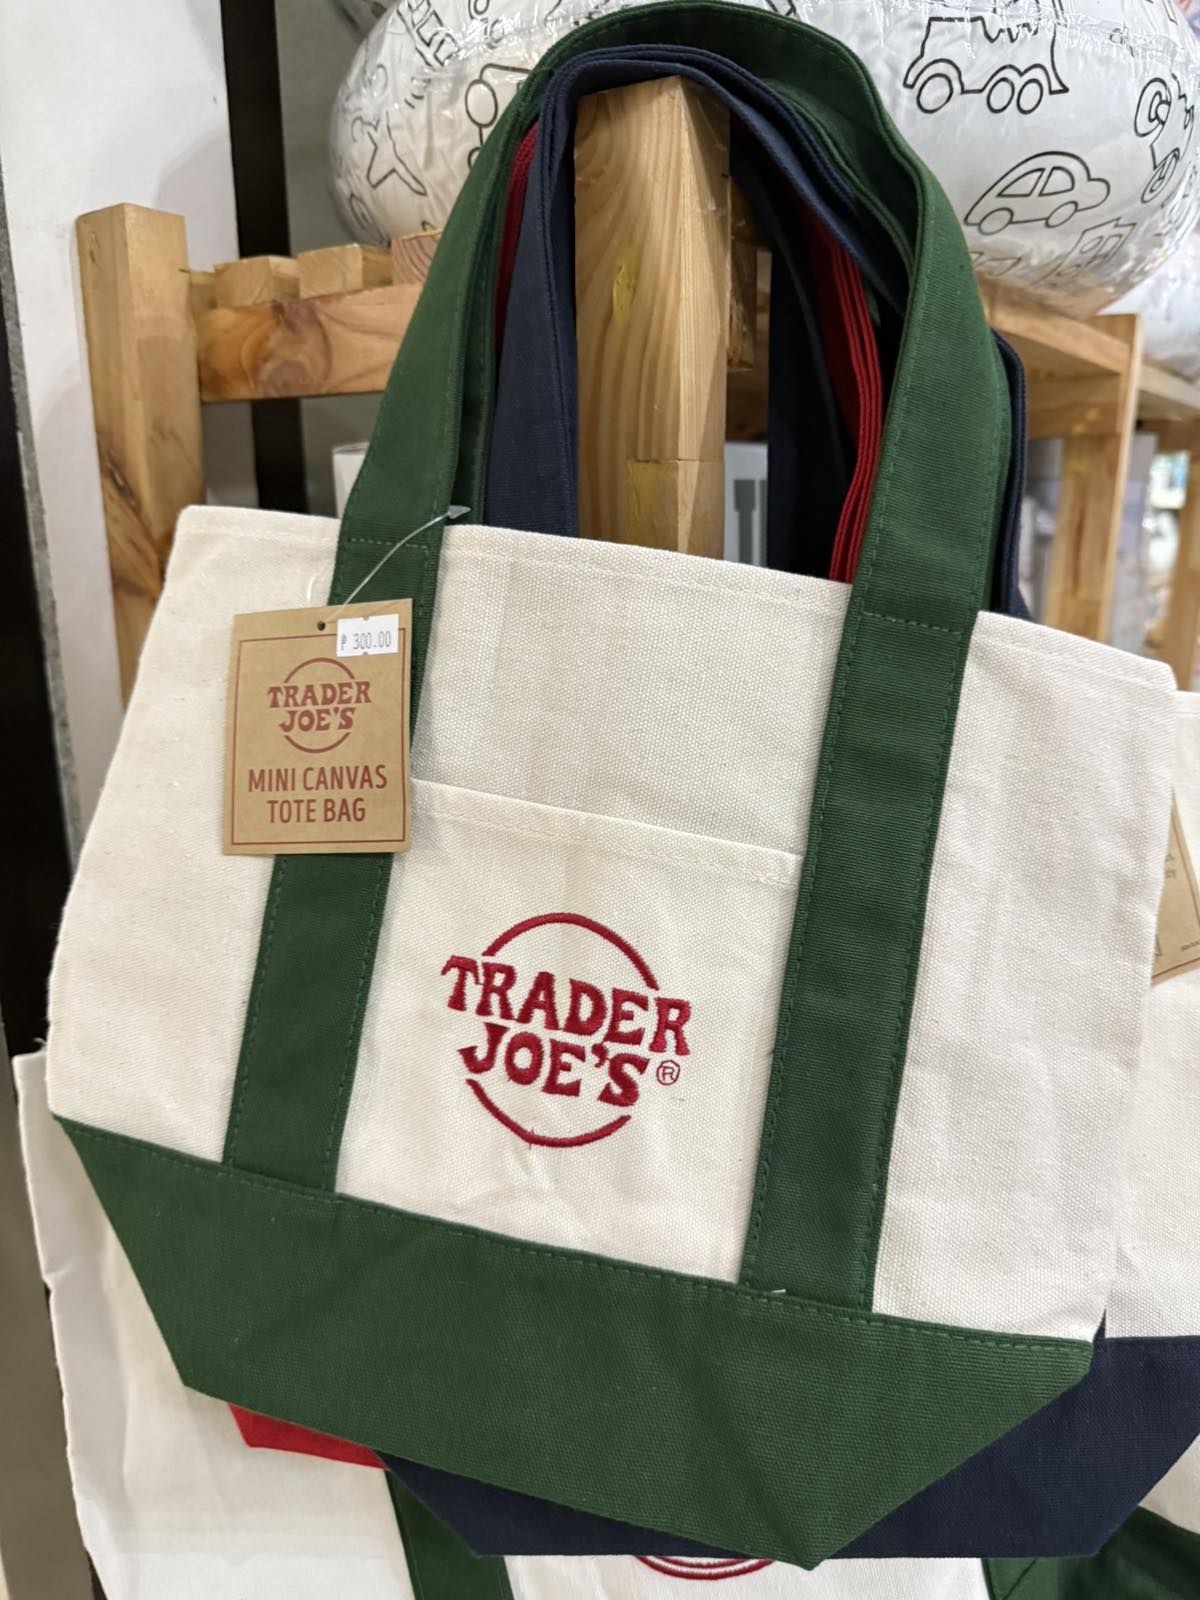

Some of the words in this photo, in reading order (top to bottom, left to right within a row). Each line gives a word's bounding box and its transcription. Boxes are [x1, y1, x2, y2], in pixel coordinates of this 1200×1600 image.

[352, 630, 392, 650] 300.00
[267, 681, 372, 708] TRADER
[278, 707, 356, 732] JOE'S
[248, 767, 296, 793] MINI
[303, 764, 388, 791] CANVAS
[267, 799, 317, 824] TOTE
[323, 797, 366, 822] BAG
[441, 955, 692, 1056] TRADER
[457, 1022, 651, 1107] JOE'S
